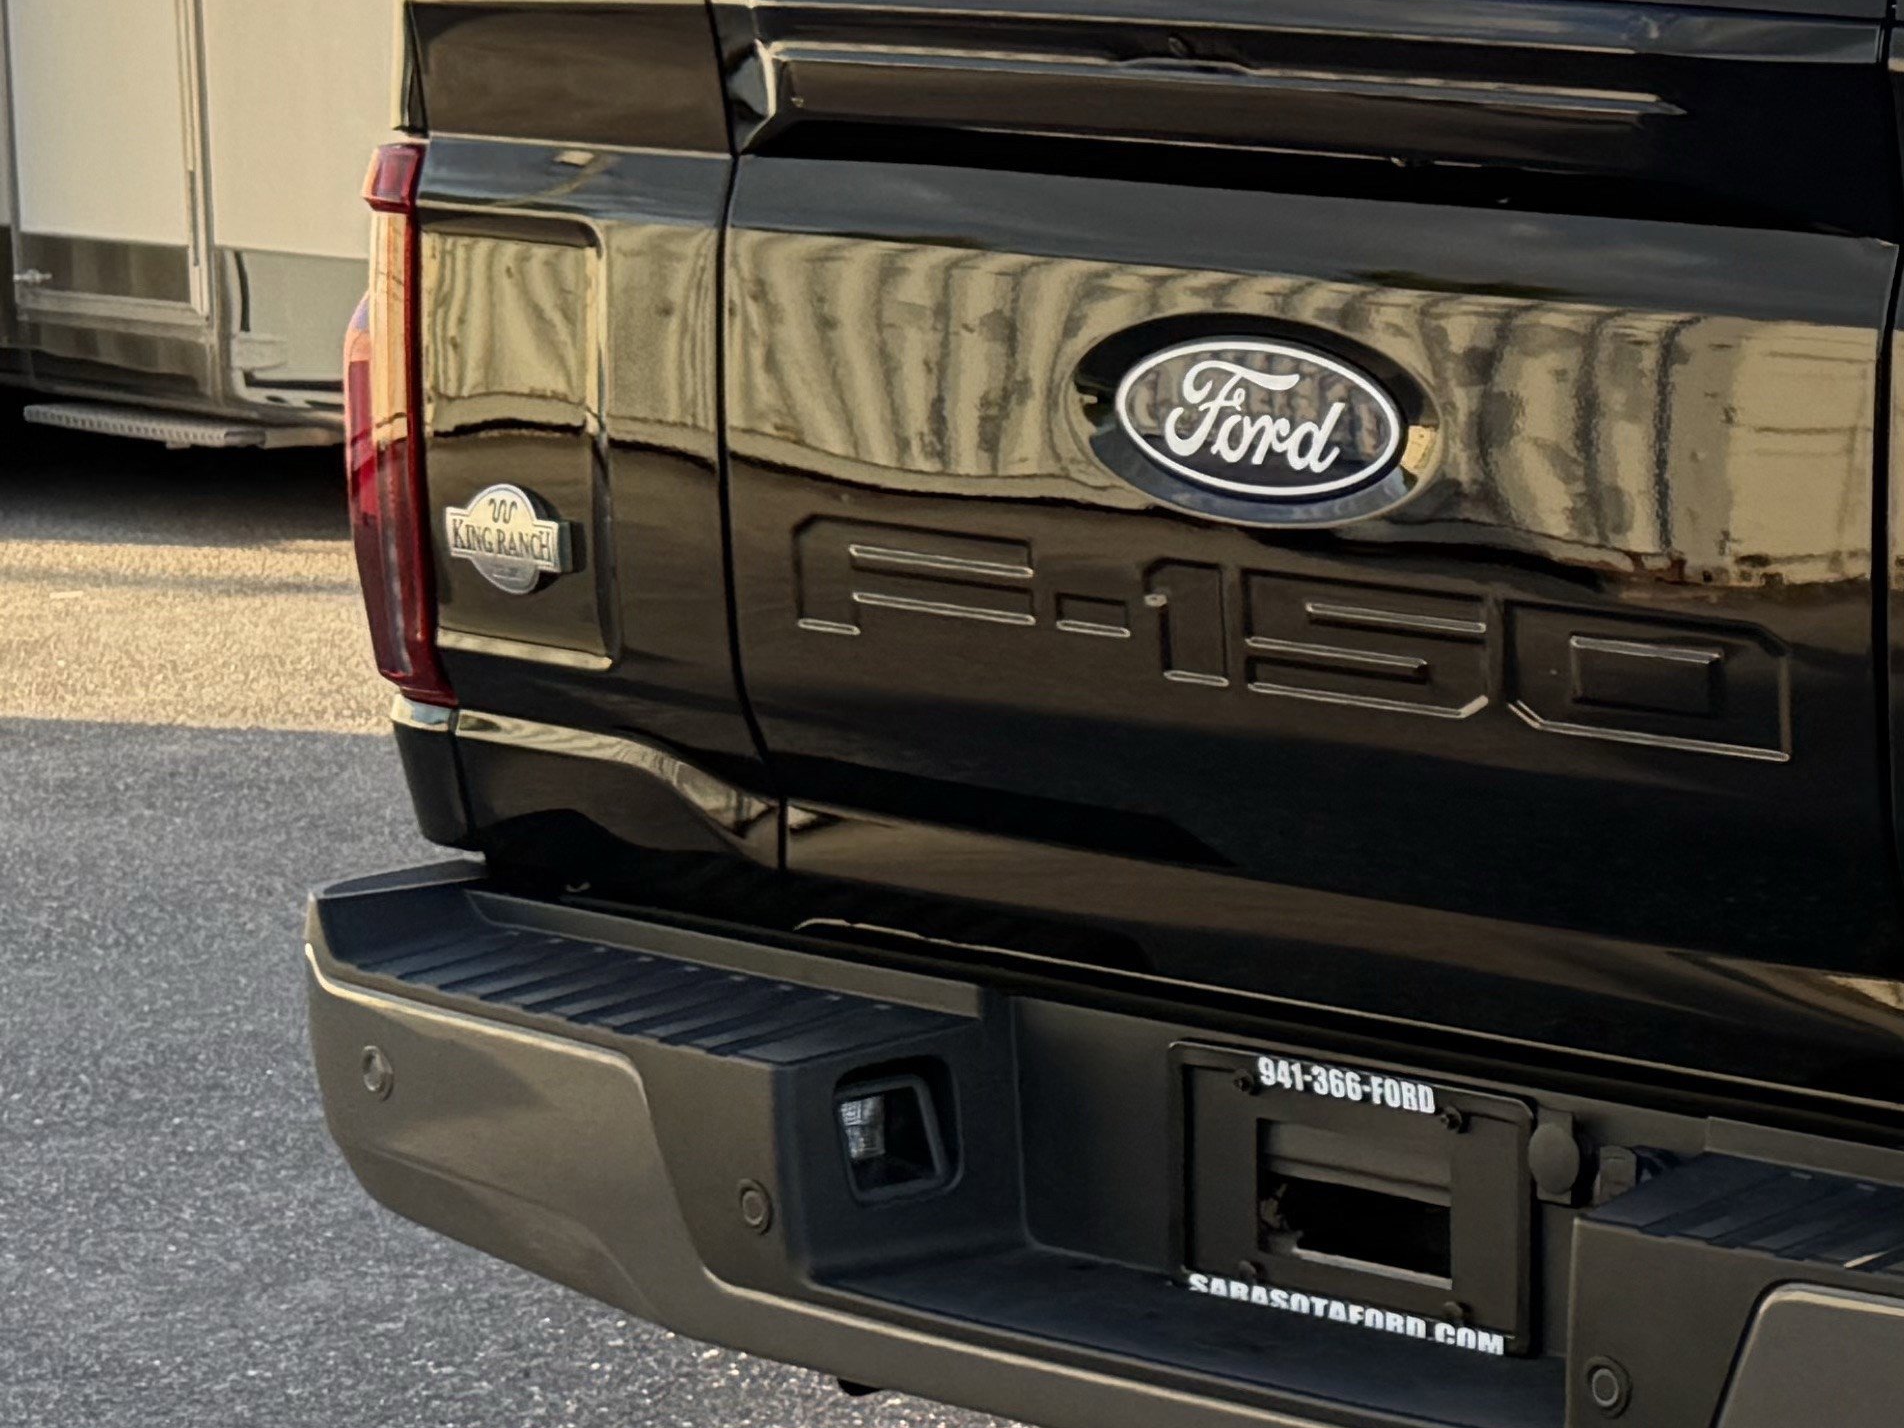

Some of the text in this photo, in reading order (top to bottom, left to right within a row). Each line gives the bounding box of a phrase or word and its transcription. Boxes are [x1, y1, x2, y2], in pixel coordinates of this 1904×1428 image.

[1162, 359, 1347, 475] Ford
[451, 517, 551, 563] KING RANCH
[794, 513, 1792, 763] F-150
[1257, 1056, 1437, 1115] 941-366-FORD
